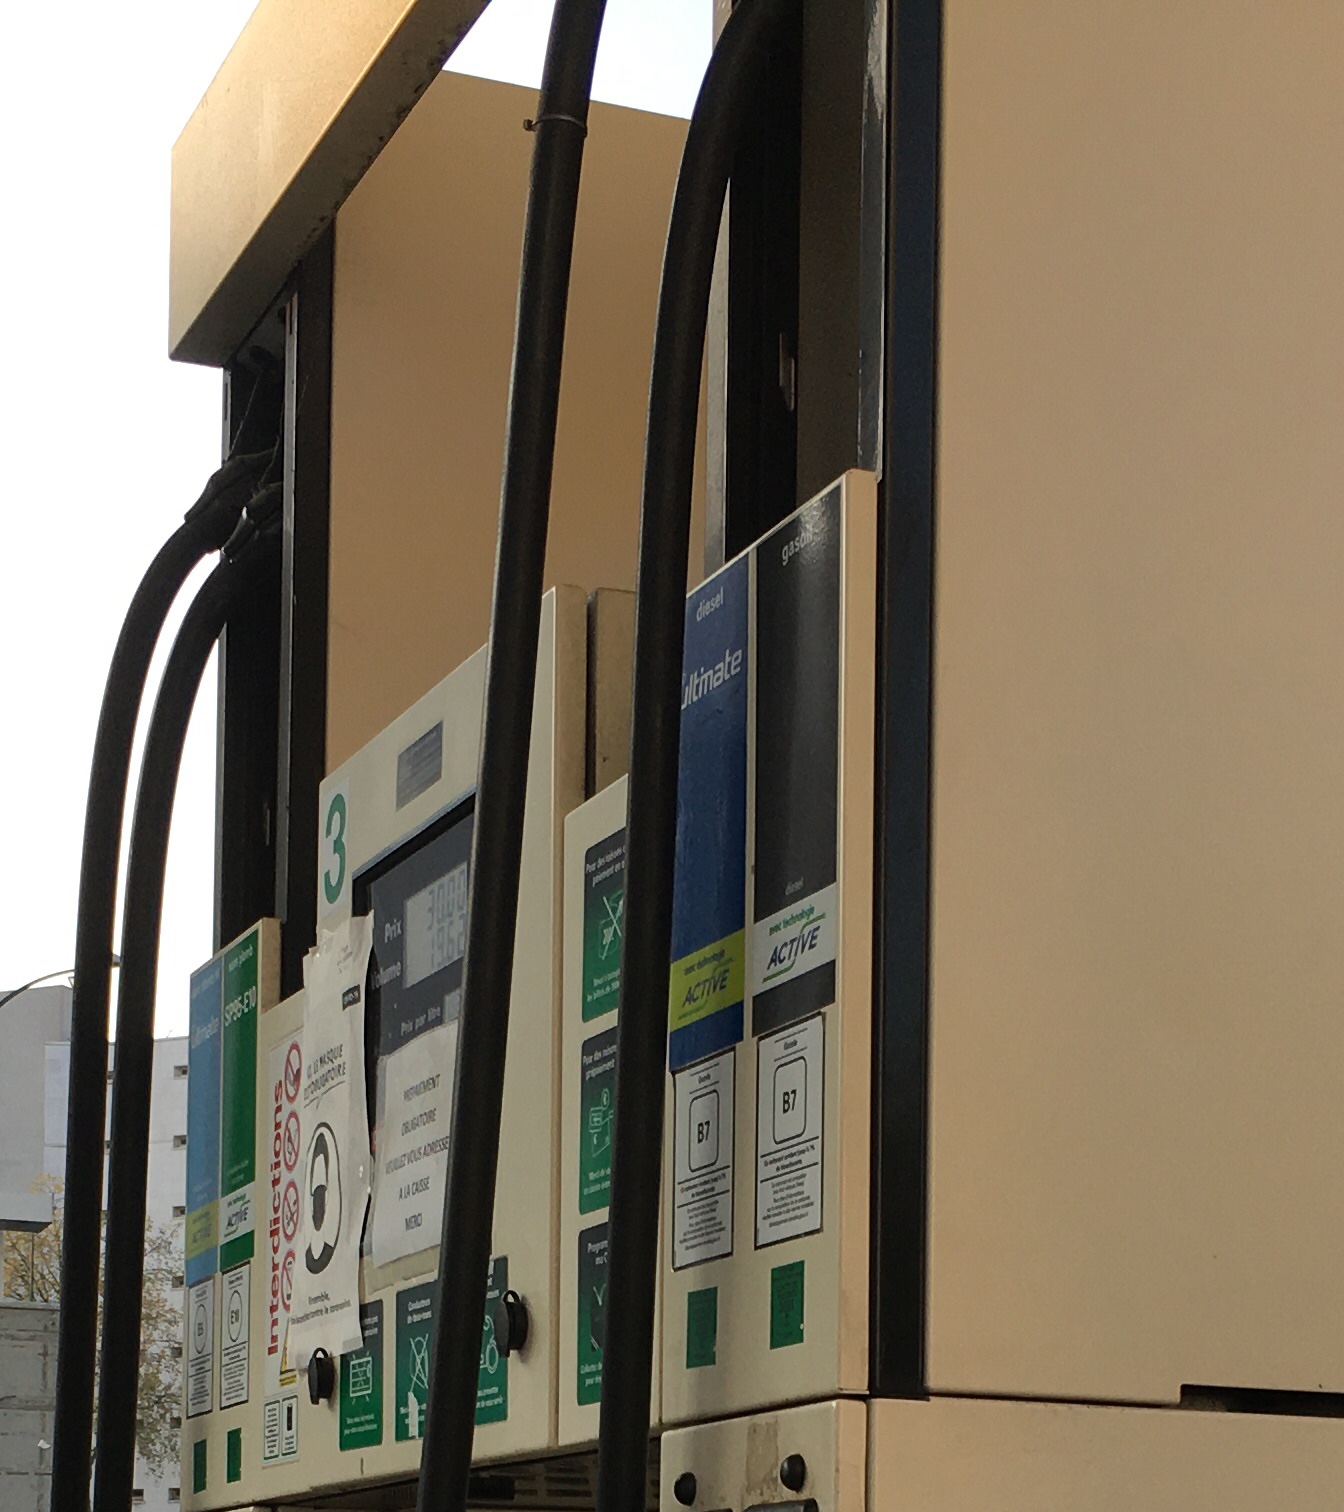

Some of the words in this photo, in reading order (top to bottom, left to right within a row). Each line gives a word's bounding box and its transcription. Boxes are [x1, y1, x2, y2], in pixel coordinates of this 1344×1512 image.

[696, 586, 724, 622] diesel
[324, 793, 346, 904] 3
[384, 918, 403, 944] Prix
[766, 925, 821, 971] ACTIVE
[682, 968, 730, 1009] ACTIVE
[782, 1088, 797, 1114] B7
[401, 1107, 437, 1137] OBLIGATOIRE
[697, 1120, 711, 1144] B7
[407, 1148, 423, 1166] VOUS
[404, 1183, 411, 1199] LA
[411, 1176, 430, 1197] CAISSE
[225, 1207, 249, 1231] ACTIVE
[267, 1079, 284, 1356] Interdictions
[404, 1213, 423, 1232] MERCI
